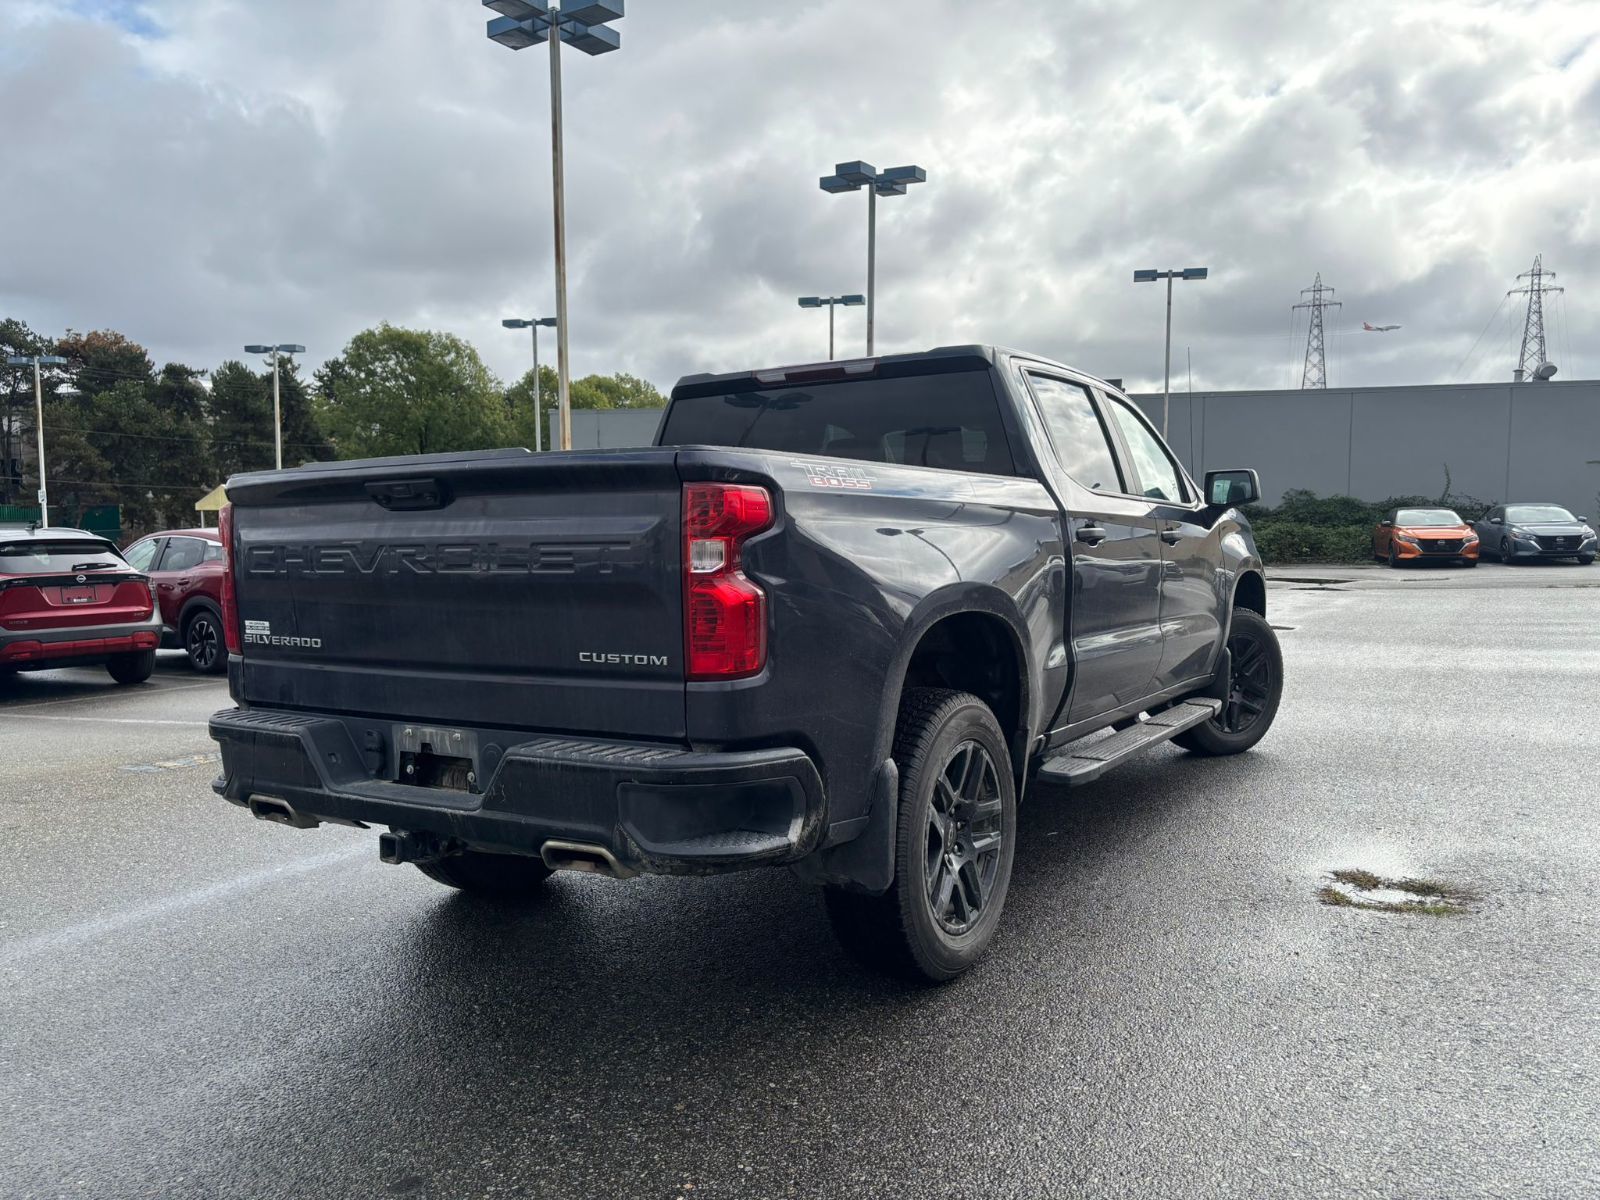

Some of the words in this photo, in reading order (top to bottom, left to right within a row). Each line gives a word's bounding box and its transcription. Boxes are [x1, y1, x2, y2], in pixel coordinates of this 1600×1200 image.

[790, 462, 878, 482] TRAIL
[808, 475, 872, 490] BOSS
[247, 541, 632, 577] CHEVROLET
[243, 633, 322, 649] SILVERADO
[578, 651, 669, 667] CUSTOM
